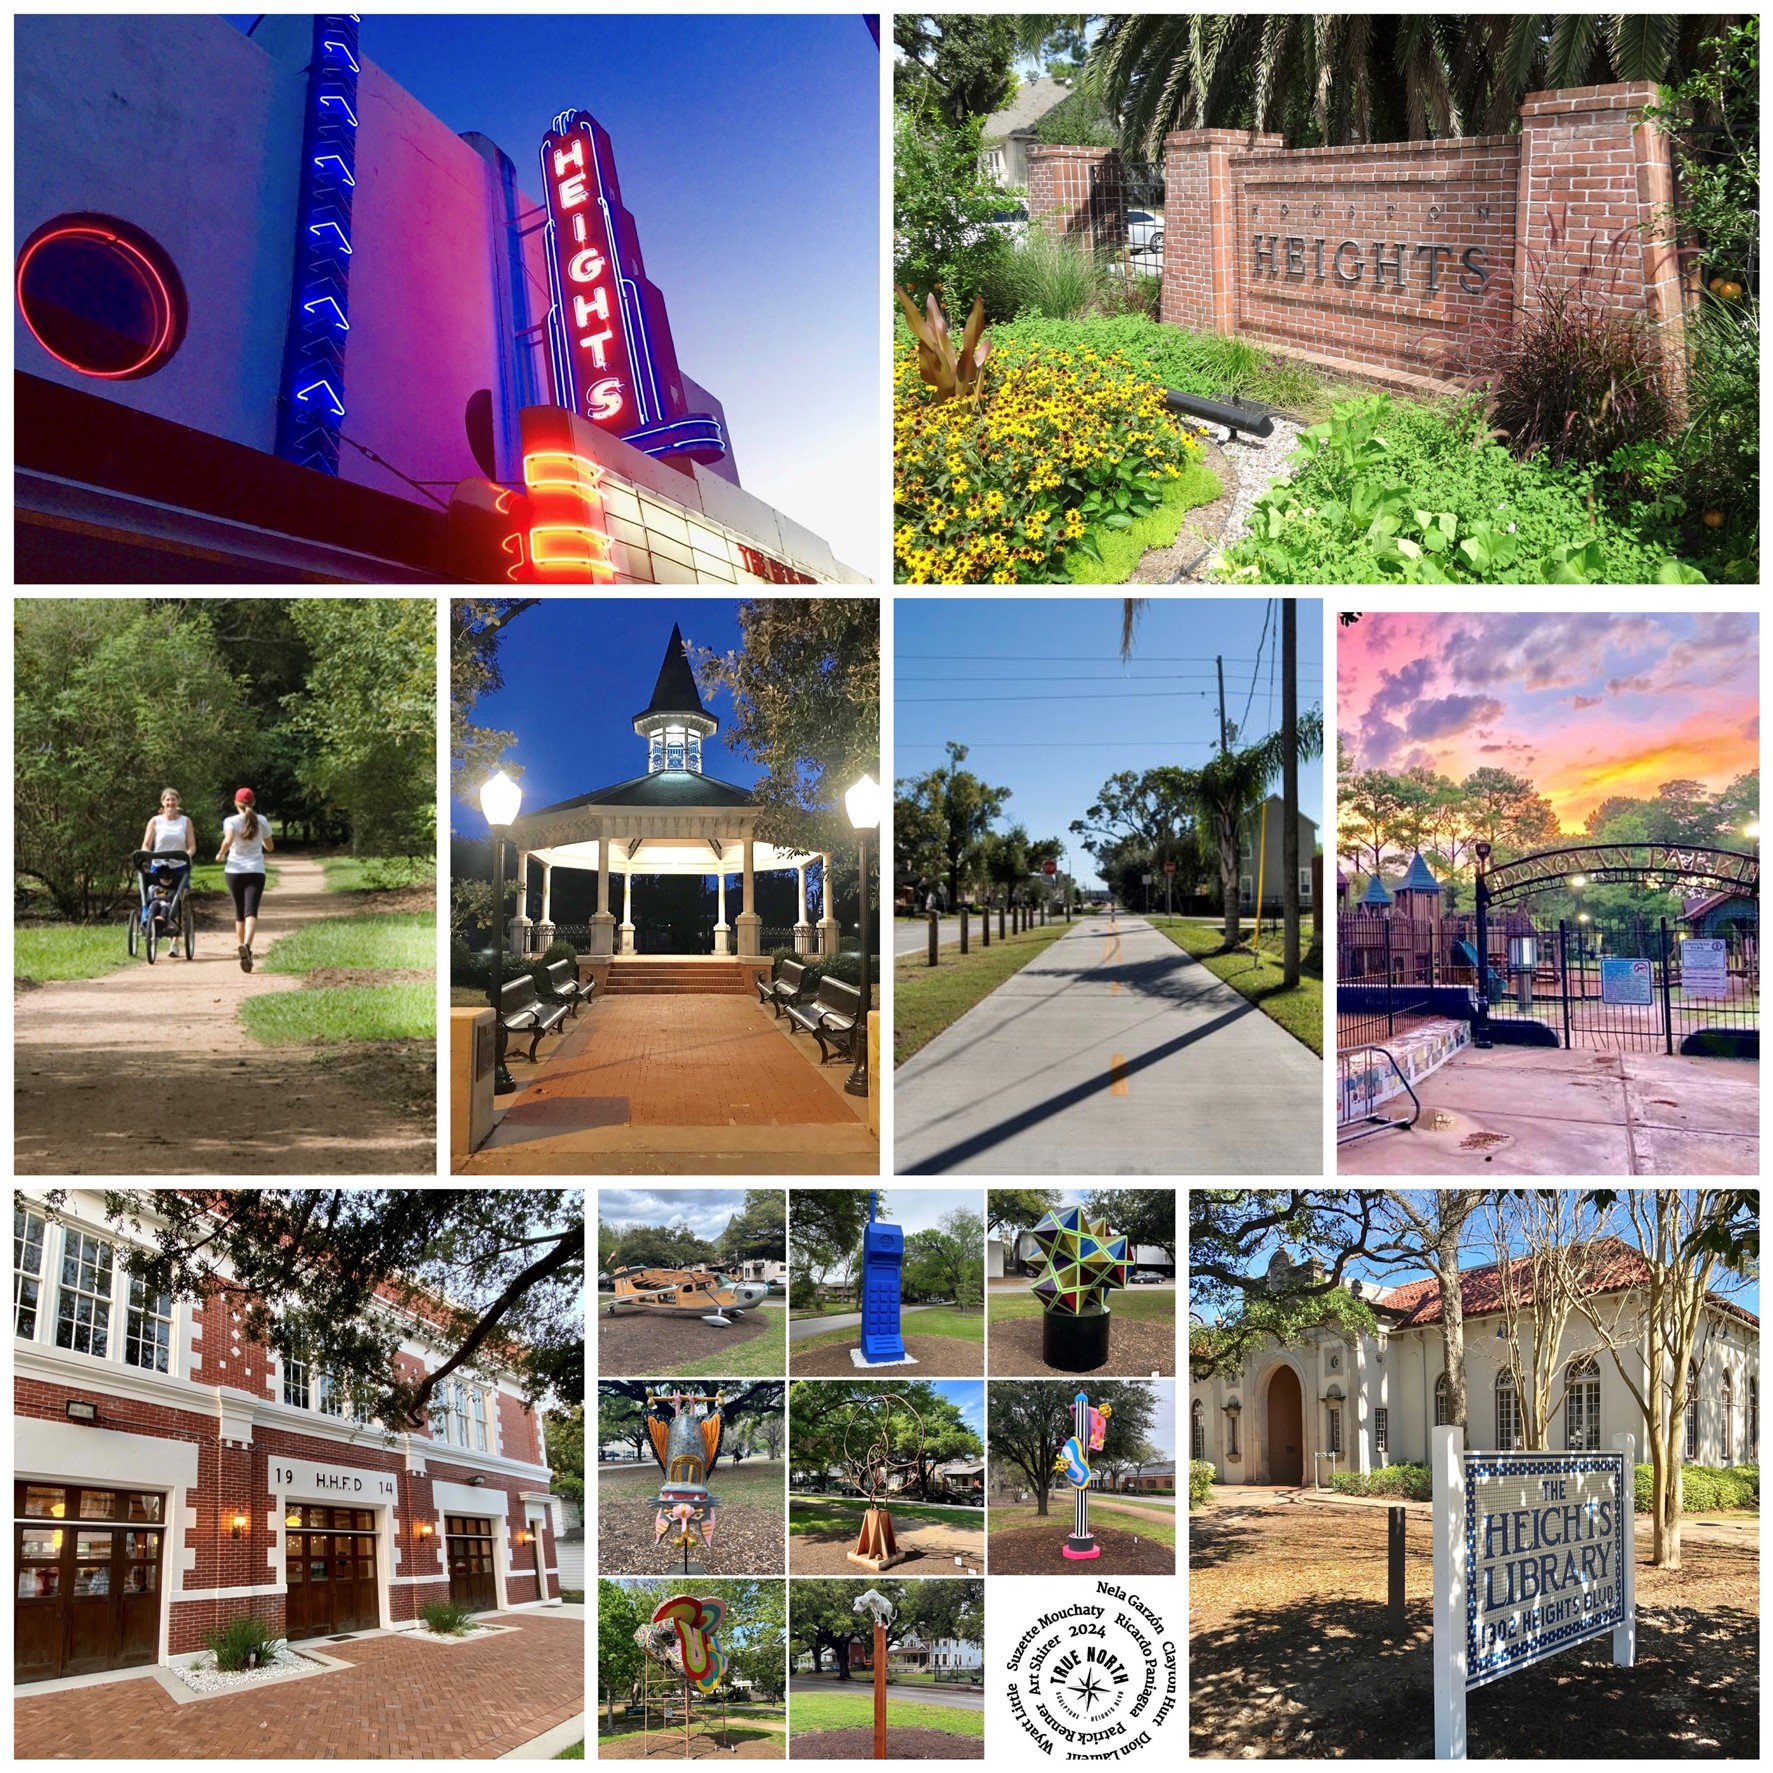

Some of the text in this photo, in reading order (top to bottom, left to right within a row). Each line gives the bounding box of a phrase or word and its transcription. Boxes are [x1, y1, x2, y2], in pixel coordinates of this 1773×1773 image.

[1252, 203, 1490, 220] HOUSTON
[553, 138, 625, 420] HEIGHTS
[1254, 233, 1490, 294] HEIGHTS
[1501, 848, 1633, 887] DONOVAN
[1648, 847, 1737, 879] PARK
[276, 1467, 293, 1484] 19
[379, 1481, 393, 1495] 14
[1542, 1480, 1566, 1501] THE
[1484, 1501, 1612, 1559] HEIGHTS
[1484, 1541, 1612, 1612] LIBRARY
[1481, 1585, 1613, 1648] 1302 HEIGHTS BLVD
